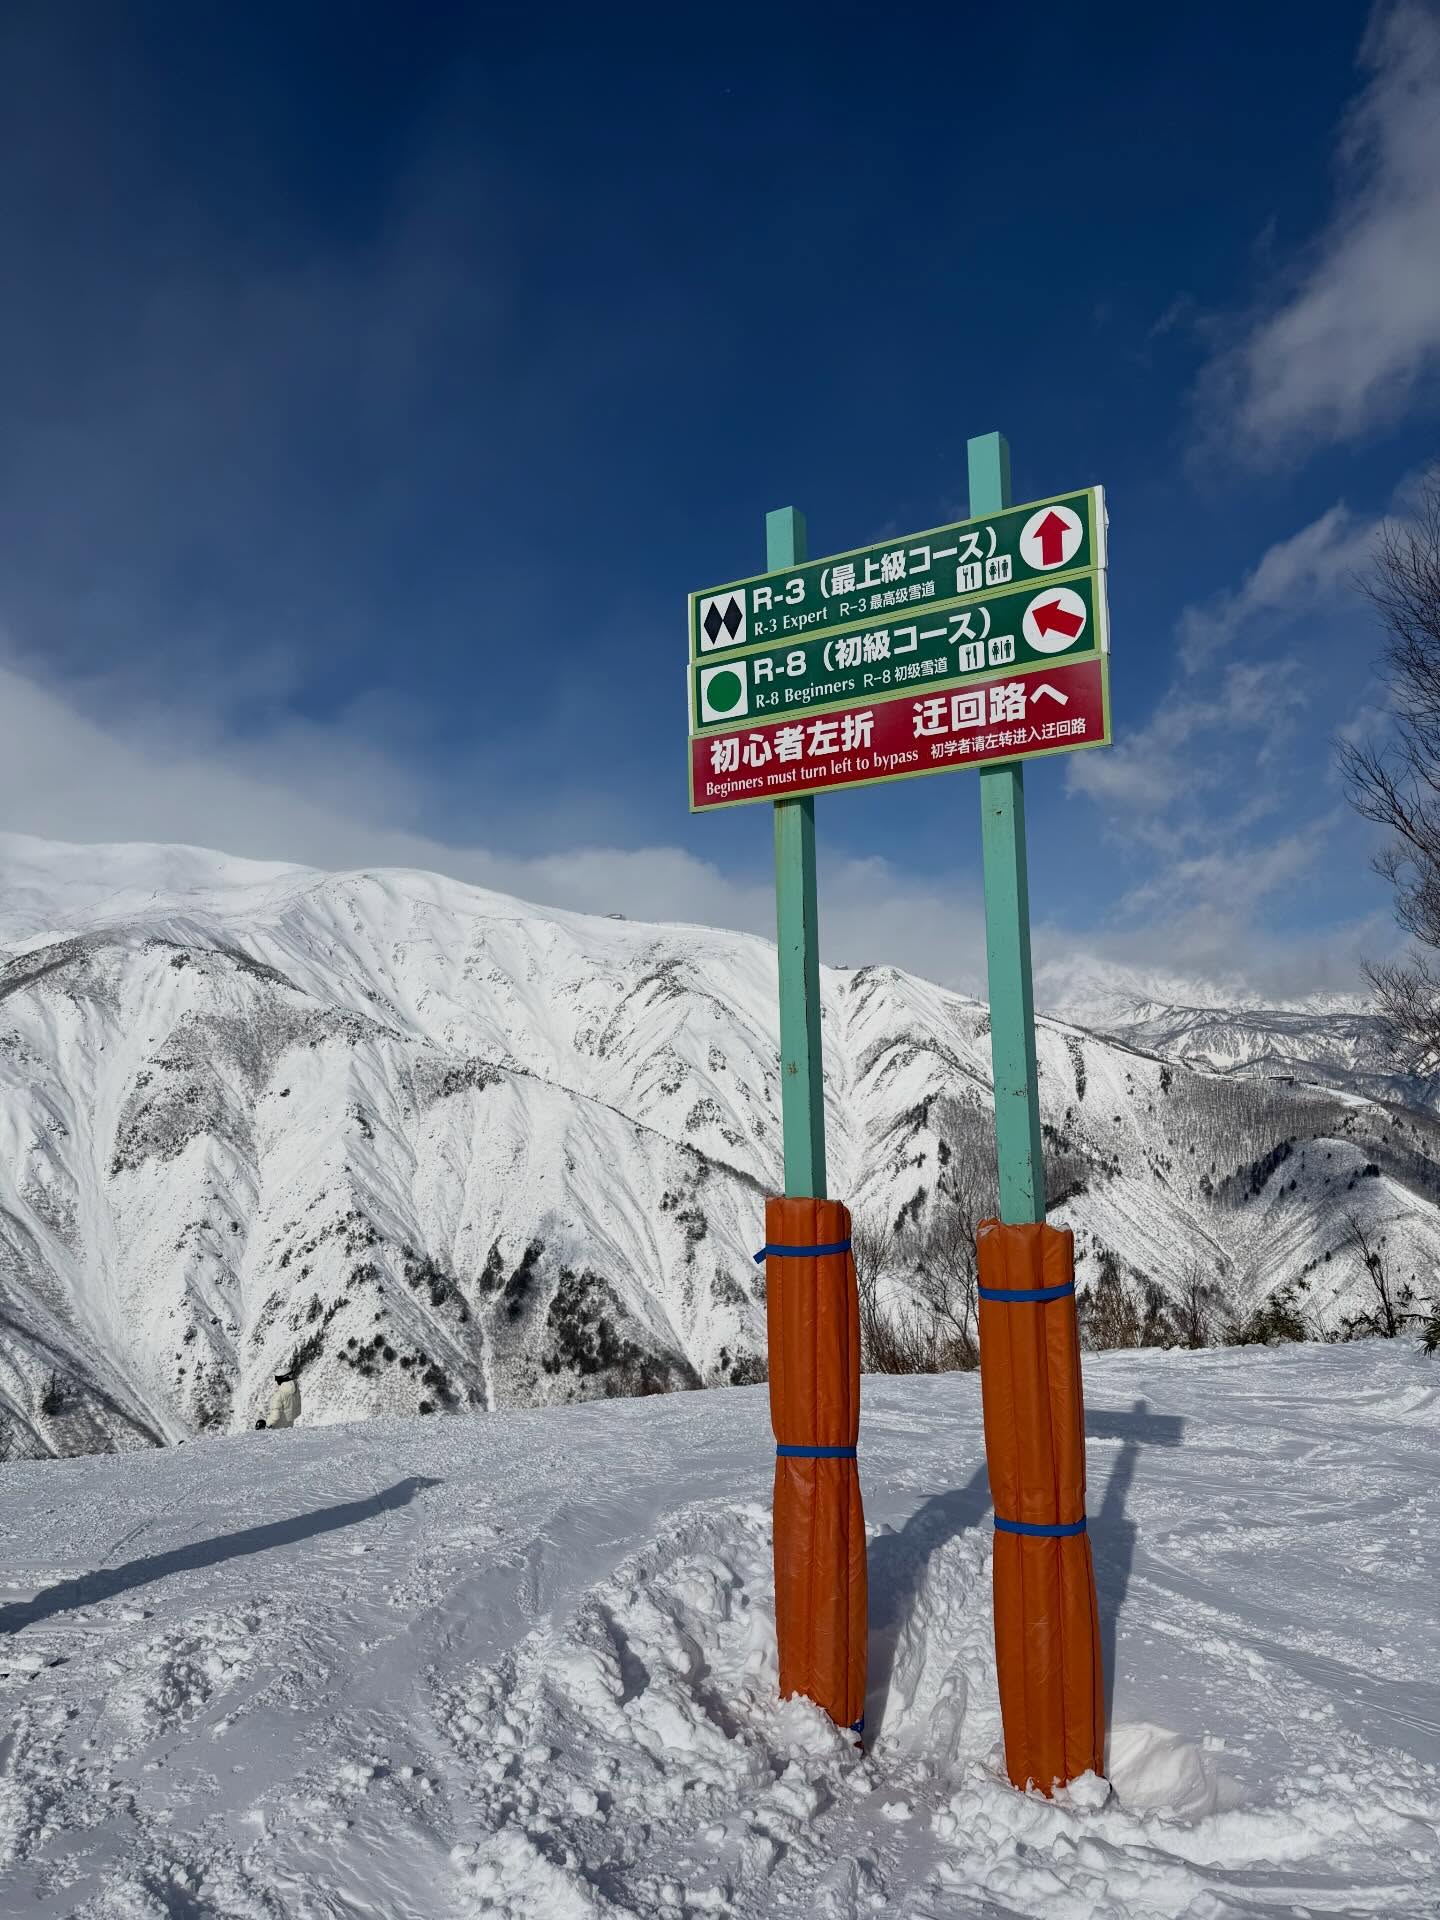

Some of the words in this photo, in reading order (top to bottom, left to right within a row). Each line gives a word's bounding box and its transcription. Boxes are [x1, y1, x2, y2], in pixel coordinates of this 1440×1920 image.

[753, 578, 805, 614] R-3
[820, 526, 997, 599] （最上級コース）
[839, 598, 867, 617] R-3
[870, 580, 935, 610] 最高级雪道
[754, 618, 777, 636] R-3
[783, 606, 828, 630] Expert
[753, 650, 807, 684] R-8
[823, 606, 991, 672] （初級コース）
[863, 670, 891, 688] R-8
[894, 656, 948, 682] 初级雪道
[755, 692, 779, 709] R-8
[784, 678, 855, 703] Beginners
[710, 710, 875, 775] 初心者左折
[912, 682, 1069, 739] 迂回路へ
[931, 717, 1086, 759] 初学者请左转进入迂回路
[706, 778, 764, 798] Beginners
[767, 770, 797, 786] must
[800, 766, 827, 780] turn
[831, 757, 852, 775] left
[856, 758, 870, 771] to
[873, 749, 919, 771] bypass
